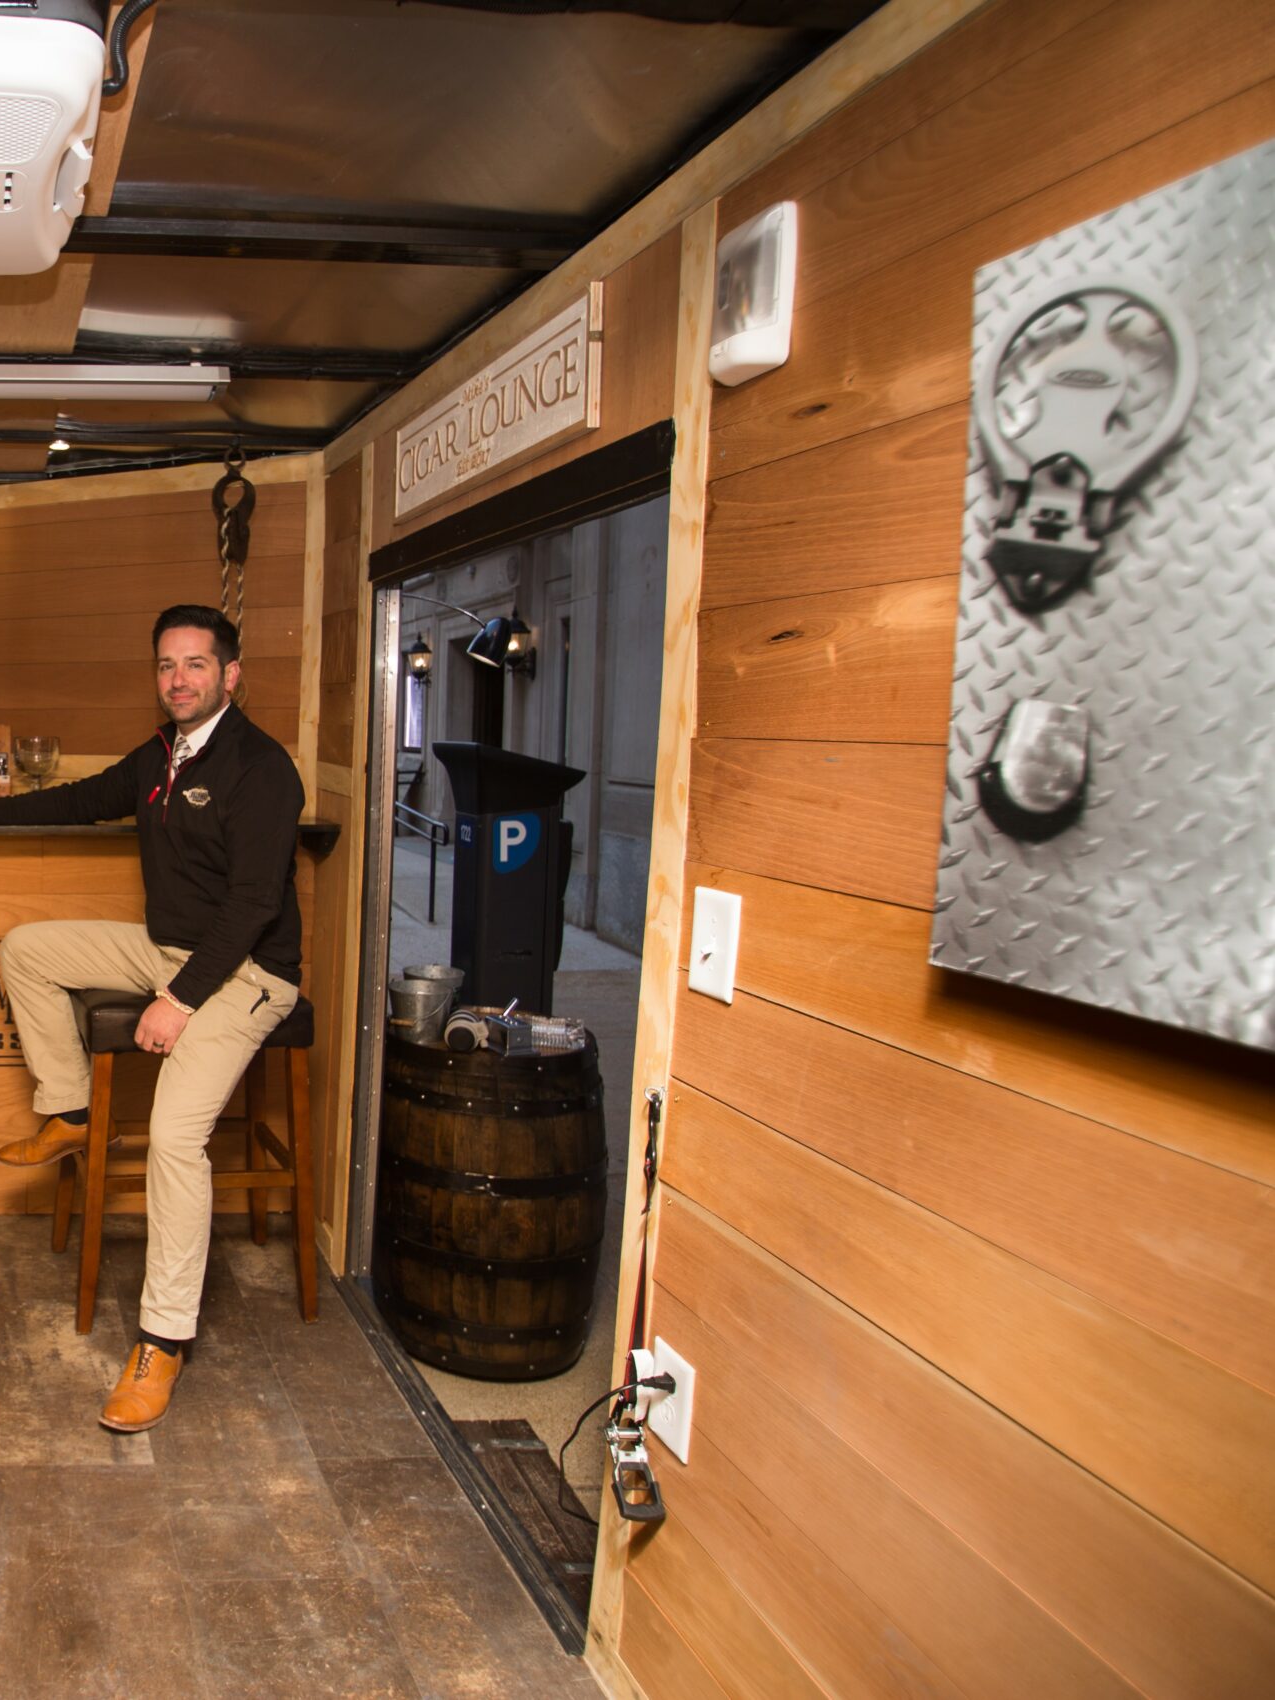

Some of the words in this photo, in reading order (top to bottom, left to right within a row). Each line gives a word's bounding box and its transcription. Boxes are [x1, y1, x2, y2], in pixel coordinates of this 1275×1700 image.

[399, 421, 461, 493] CIGAR
[468, 337, 581, 449] LOUNGE
[500, 820, 527, 862] P
